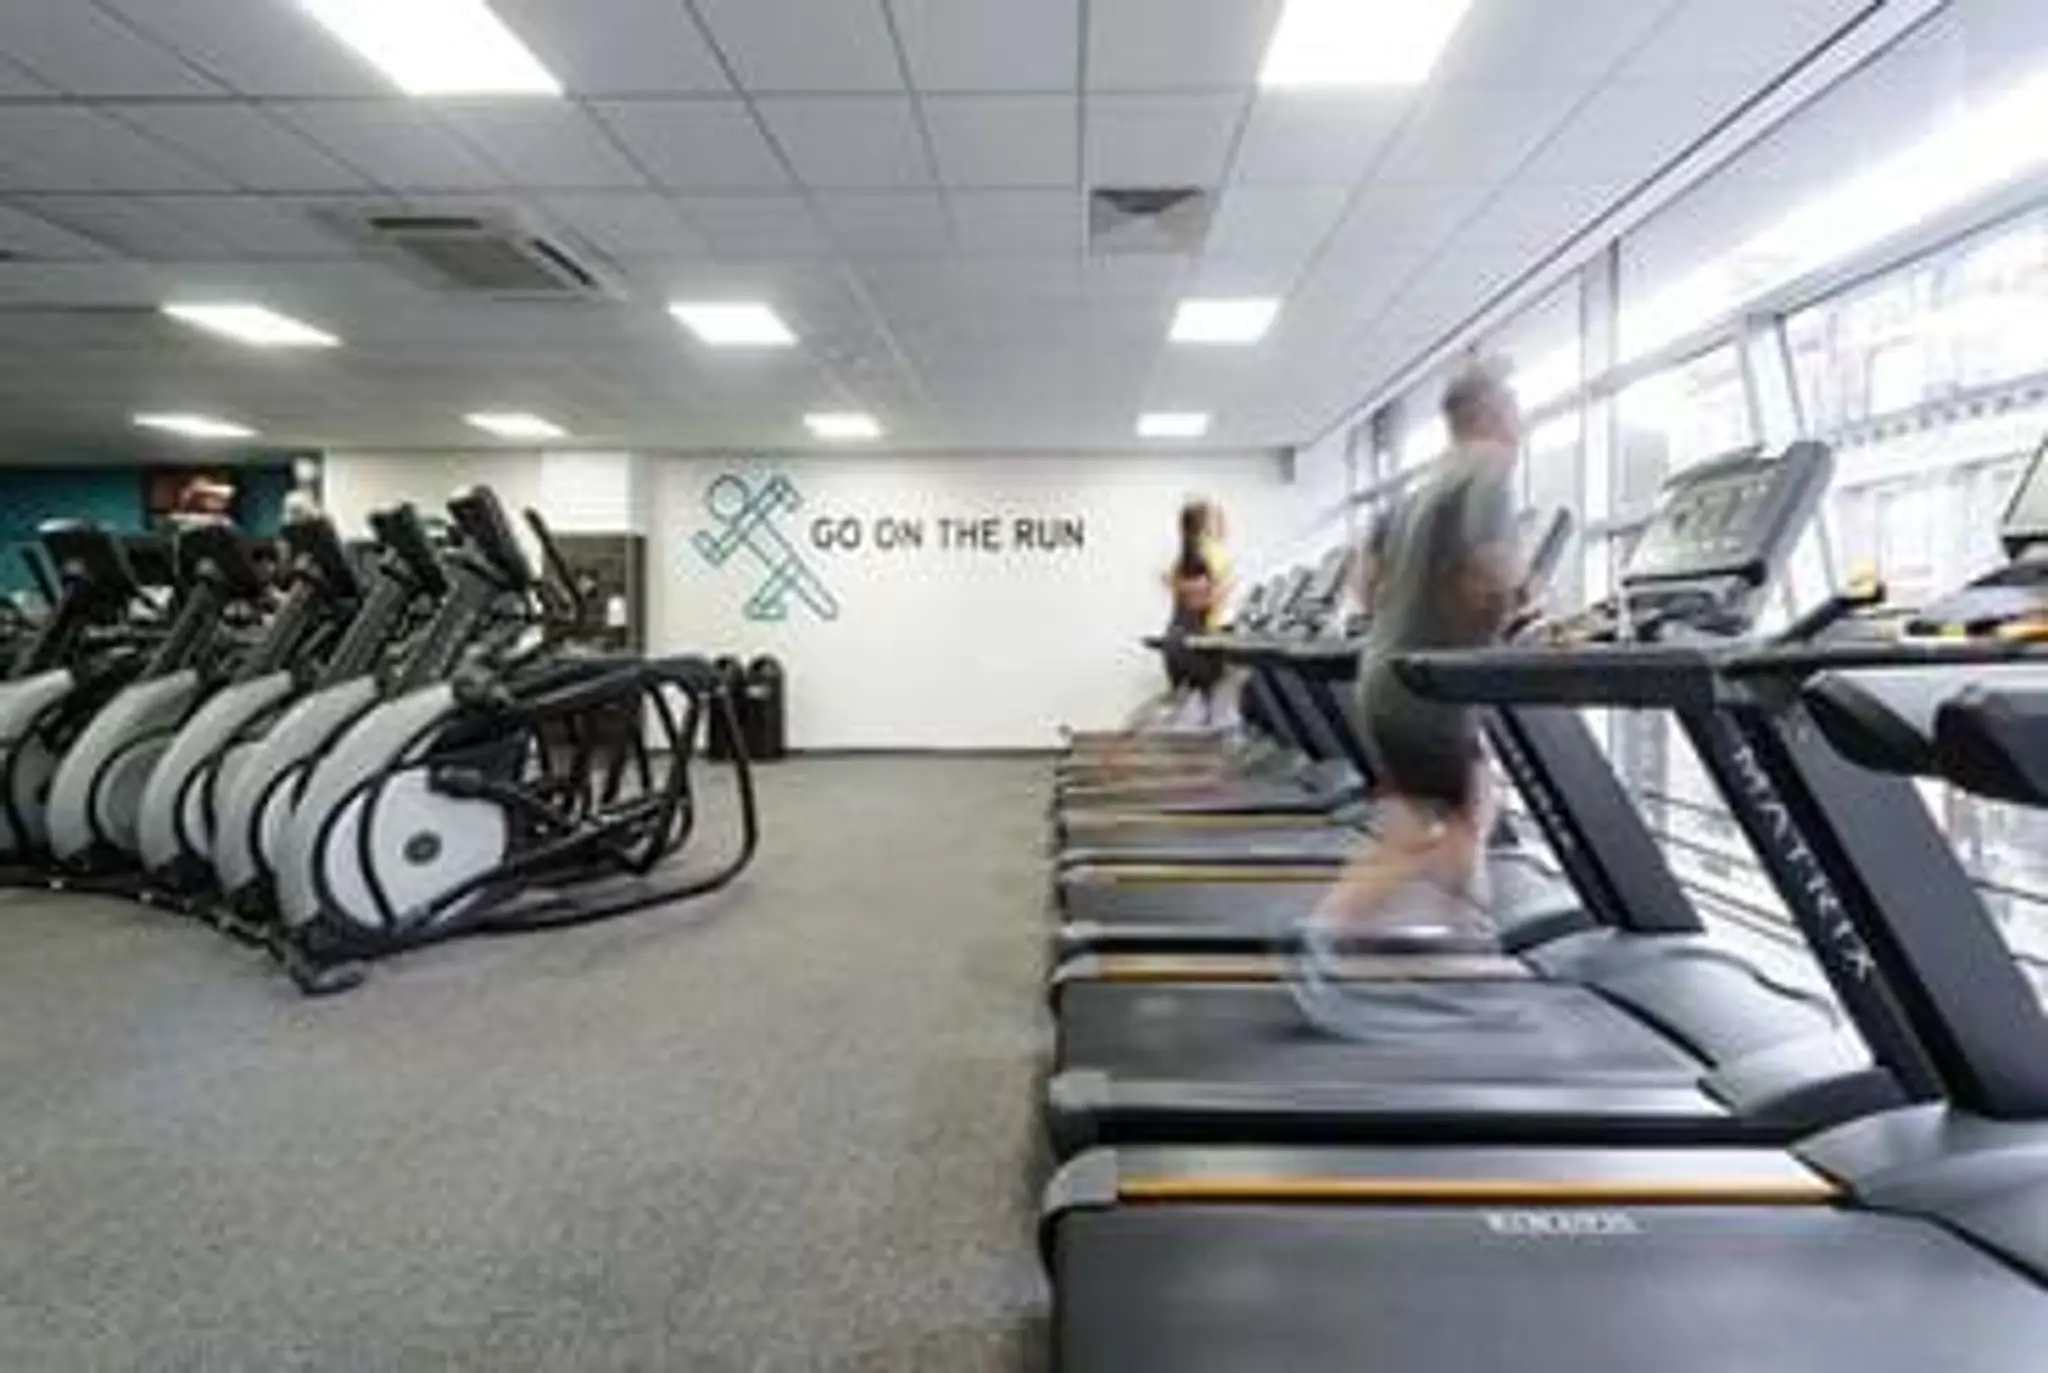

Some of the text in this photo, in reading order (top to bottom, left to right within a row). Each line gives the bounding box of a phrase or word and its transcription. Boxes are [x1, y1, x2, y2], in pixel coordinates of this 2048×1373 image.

[811, 517, 1085, 550] GO ON THE RUN
[1732, 744, 1876, 982] MATRIX
